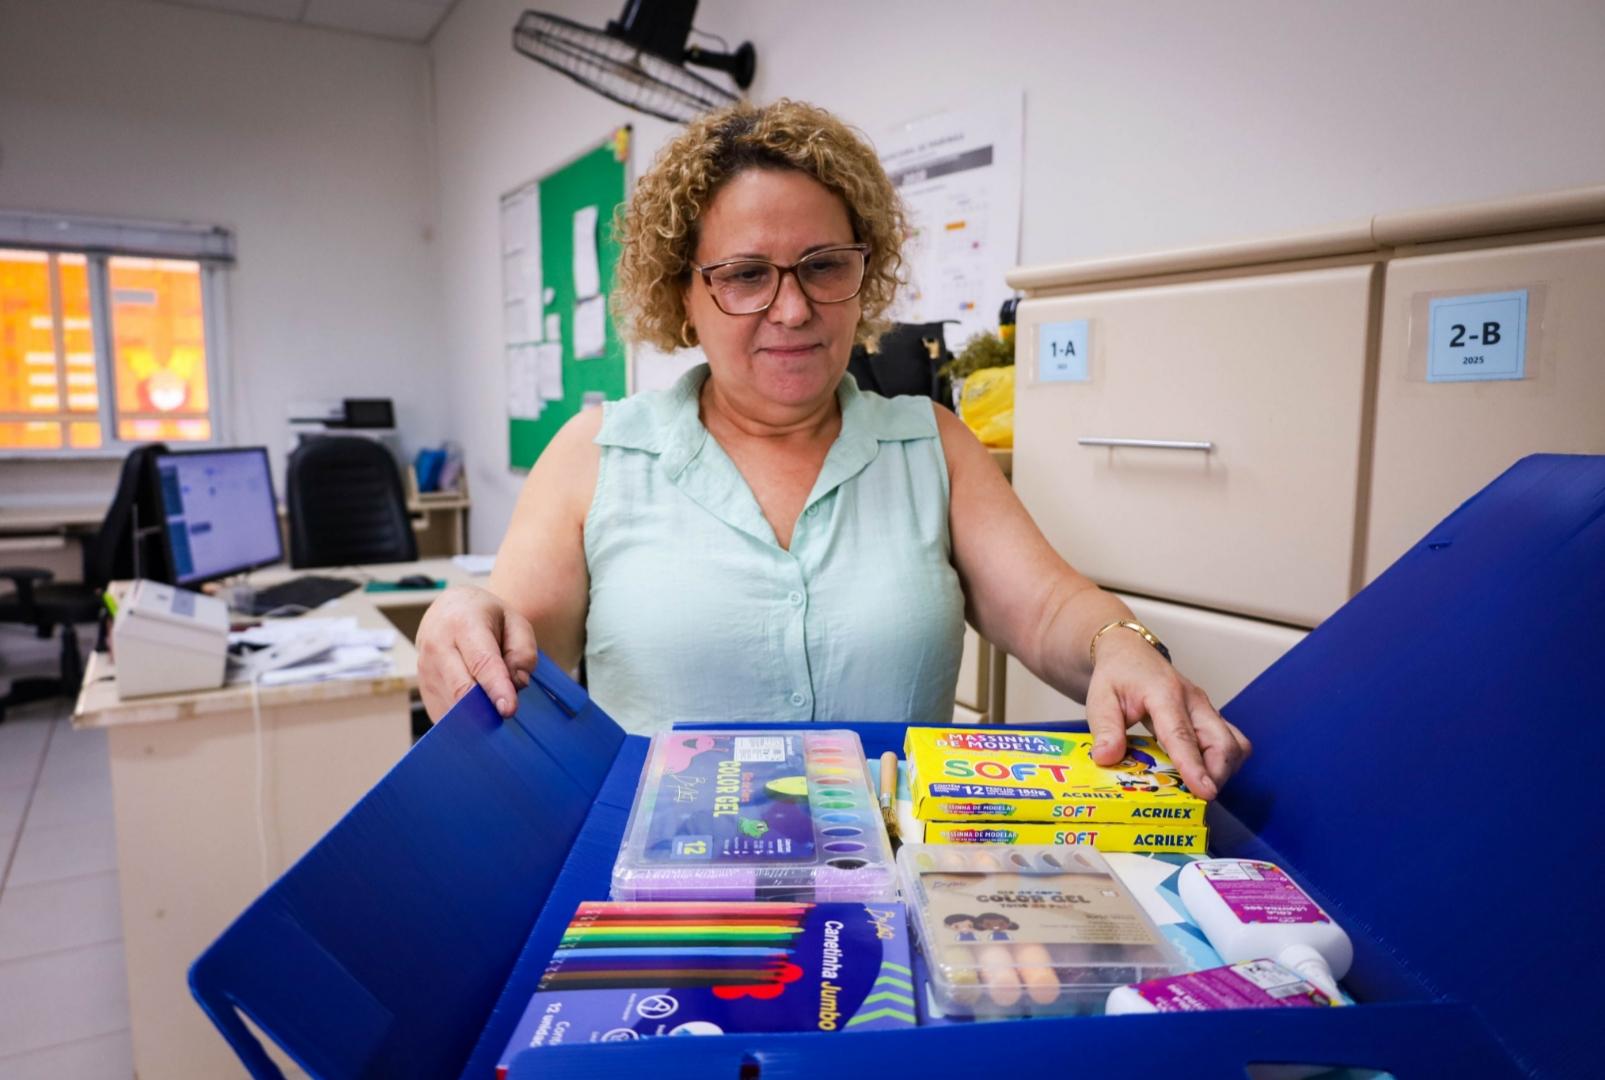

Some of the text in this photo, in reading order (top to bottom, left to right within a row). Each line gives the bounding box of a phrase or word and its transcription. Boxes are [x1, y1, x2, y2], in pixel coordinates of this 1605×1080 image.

[1449, 321, 1501, 348] 2-B
[1050, 340, 1076, 358] 1-A
[1462, 356, 1484, 365] 2025
[948, 732, 1045, 745] MASSINHA
[936, 740, 1063, 753] DE MODELAR
[943, 759, 1071, 783] SOFT
[713, 760, 741, 818] COLOR GEL
[962, 785, 985, 796] 12
[1062, 792, 1124, 800] ACRILEX
[1052, 805, 1096, 818] SOFT
[1131, 807, 1192, 819] ACRILEX
[1054, 832, 1098, 846] SOFT
[1133, 834, 1194, 847] ACRILEX
[684, 840, 705, 854] 12
[976, 894, 1091, 904] COLOR GEL
[818, 920, 844, 1031] Canetinha Jumbo
[546, 1002, 562, 1014] 12
[549, 1021, 571, 1046] Cont
